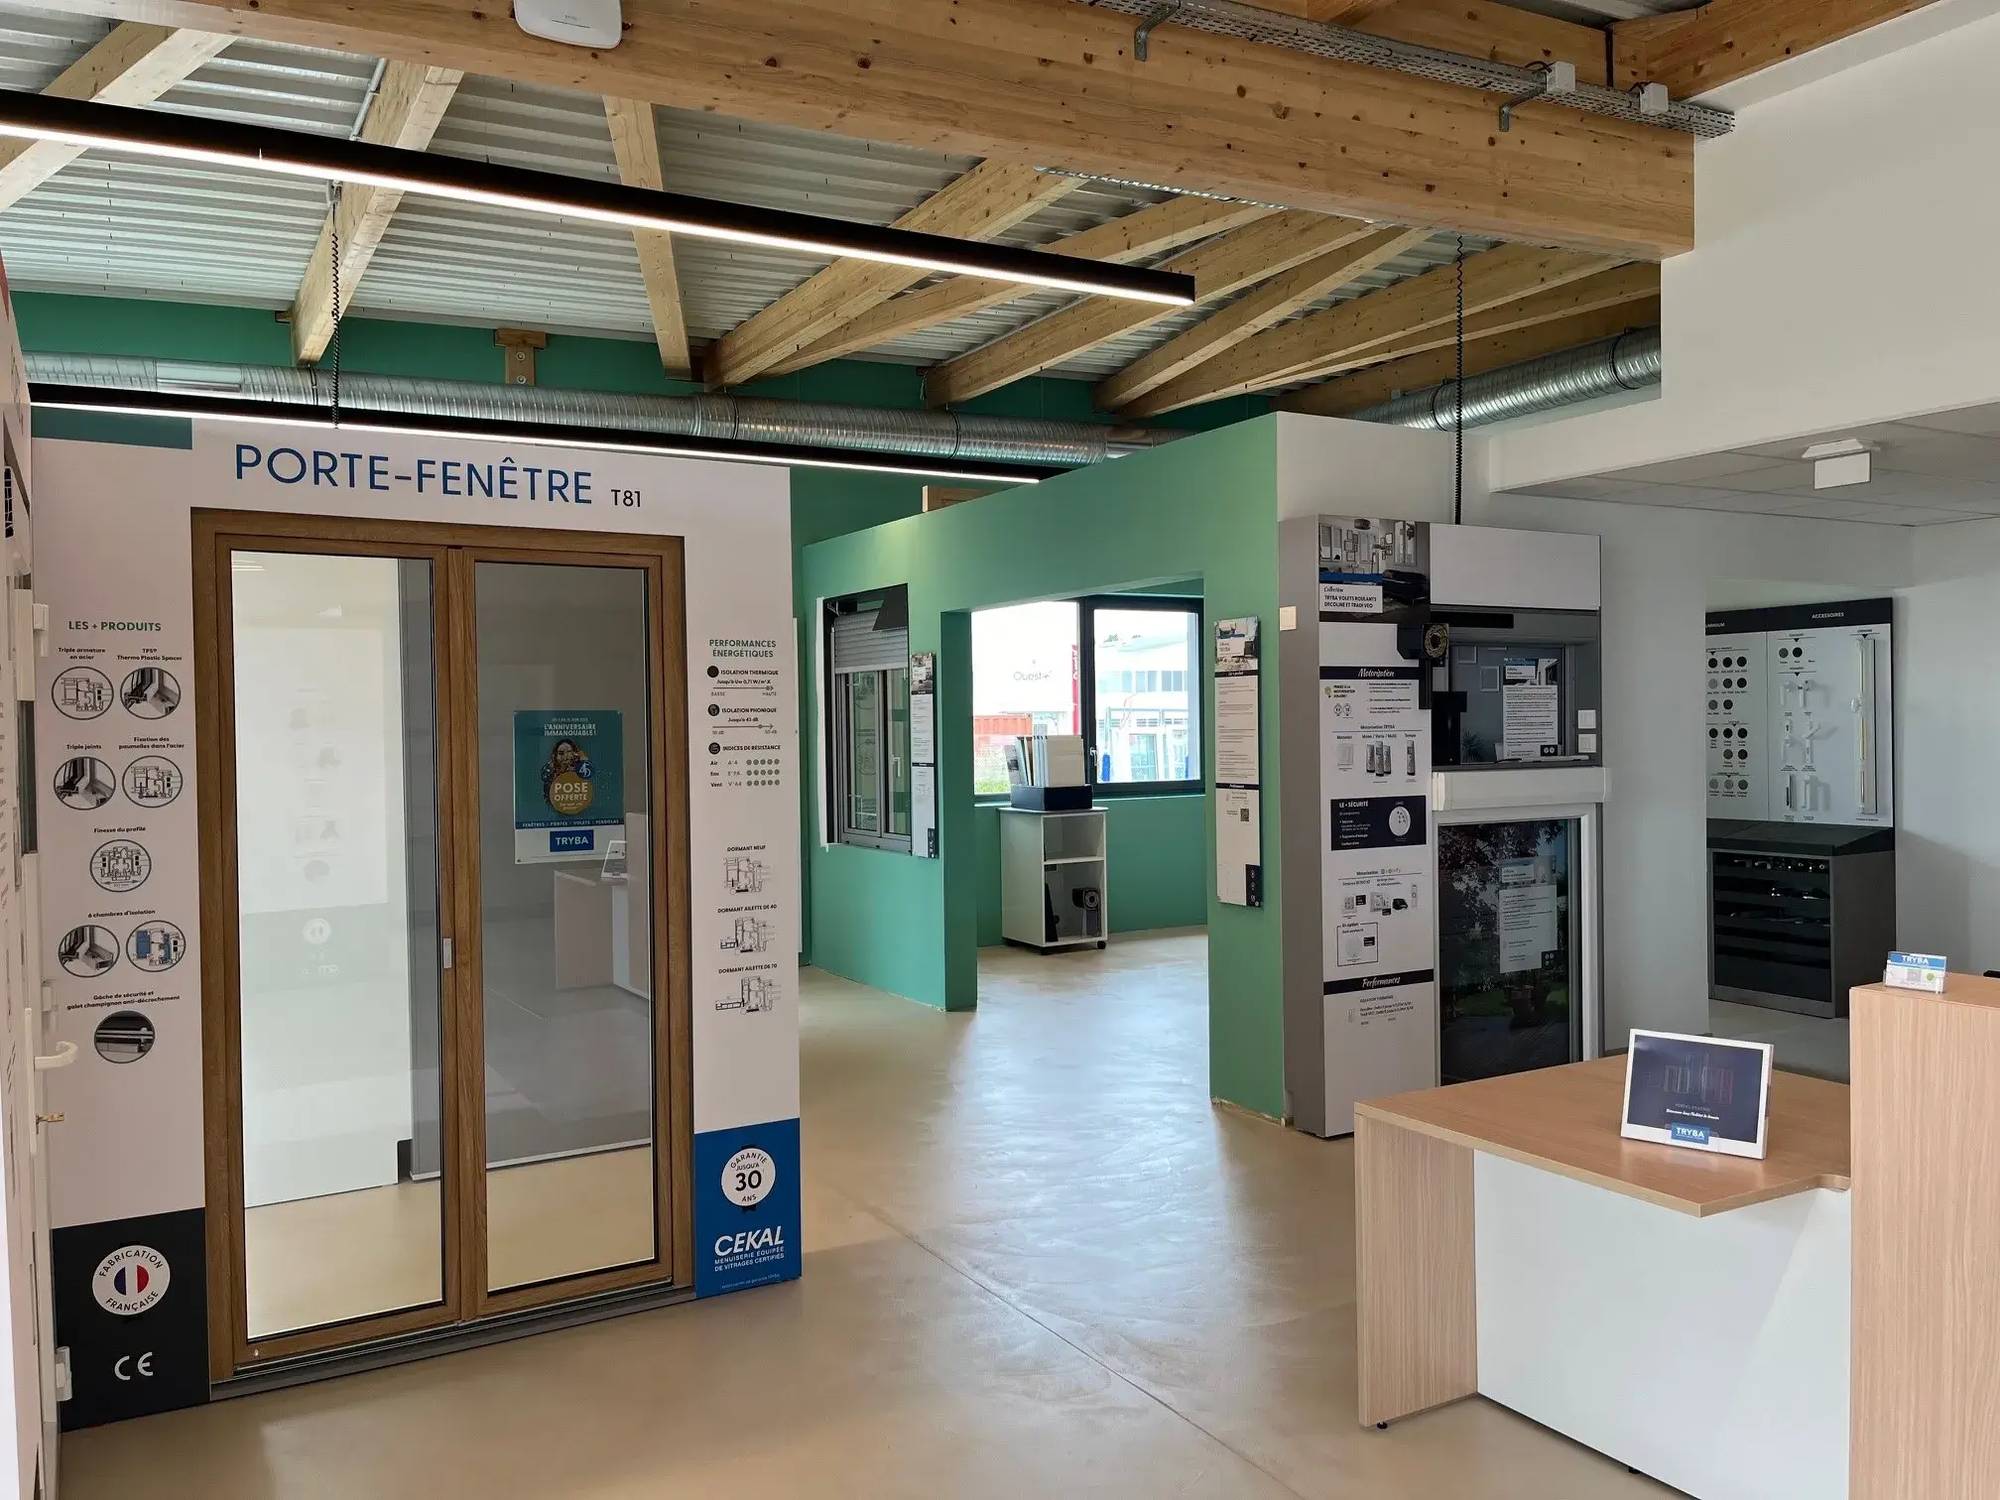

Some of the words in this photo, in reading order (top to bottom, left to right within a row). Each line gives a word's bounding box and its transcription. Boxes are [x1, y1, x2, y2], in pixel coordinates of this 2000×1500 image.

[235, 443, 592, 504] PORTE-FENÊTRE
[611, 488, 642, 508] T81
[68, 620, 89, 630] LES
[100, 621, 162, 631] PRODUITS
[709, 639, 777, 648] PERFORMANCES
[712, 647, 774, 658] ÉNERGÉTIQUES
[554, 782, 588, 794] POSE
[554, 793, 588, 801] OFFERTE
[555, 836, 589, 846] TRYBA
[717, 906, 744, 914] DORMANT
[1902, 955, 1929, 965] TRYBA
[718, 966, 745, 974] DORMANT
[1362, 976, 1401, 988] Performances
[1675, 1127, 1705, 1138] TRYBA
[730, 1152, 768, 1169] GARANTIE
[735, 1169, 762, 1192] 30
[741, 1193, 757, 1202] ANS
[714, 1225, 784, 1257] CEKAL
[98, 1249, 164, 1278] FABRICATION
[714, 1251, 755, 1265] MENUISERIE
[714, 1264, 724, 1272] DE
[723, 1258, 754, 1270] VITRAGES
[105, 1289, 159, 1312] FRANÇAISE
